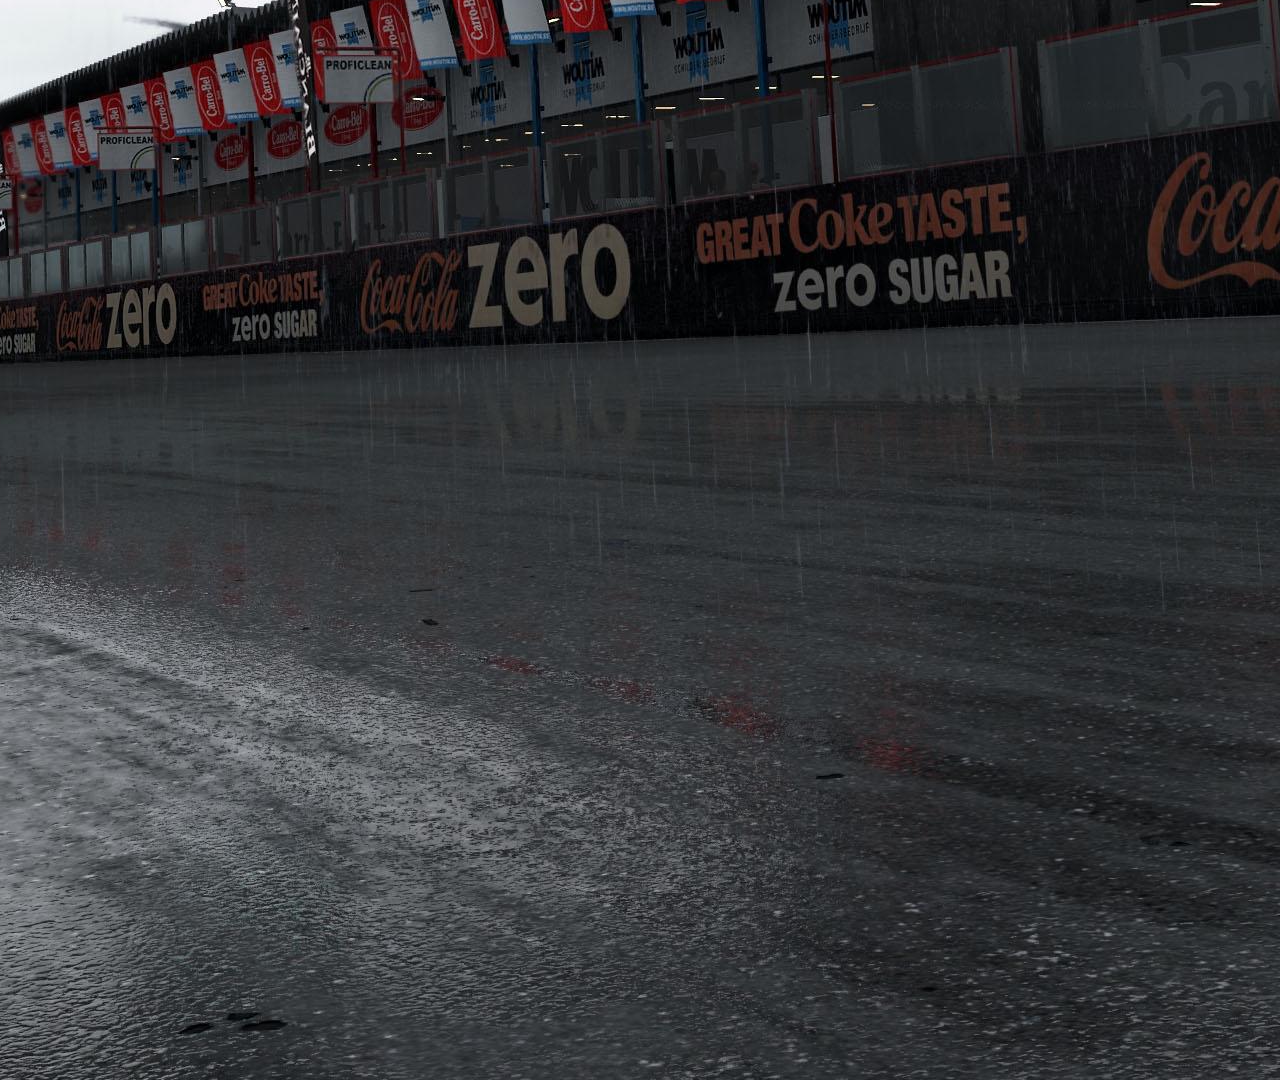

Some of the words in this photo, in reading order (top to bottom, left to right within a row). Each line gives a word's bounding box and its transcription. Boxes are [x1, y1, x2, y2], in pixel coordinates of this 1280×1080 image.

[253, 57, 274, 102] Carro-Bel
[325, 60, 392, 70] PROFICLEAN
[200, 76, 218, 117] Carro-Bel
[331, 107, 362, 132] Carro-Bel
[100, 136, 153, 145] PROFICLEAN
[696, 213, 787, 265] GREAT
[788, 192, 896, 254] Coke
[896, 182, 1030, 245] TASTE,
[202, 281, 240, 312] GREAT
[239, 272, 279, 307] Coke
[360, 247, 462, 335] Coca-Cola
[467, 223, 633, 329] zero
[774, 263, 877, 313] zero
[888, 249, 1013, 308] SUGAR
[106, 282, 178, 349] zero
[232, 312, 270, 343] zero
[274, 308, 318, 340] SUGAR
